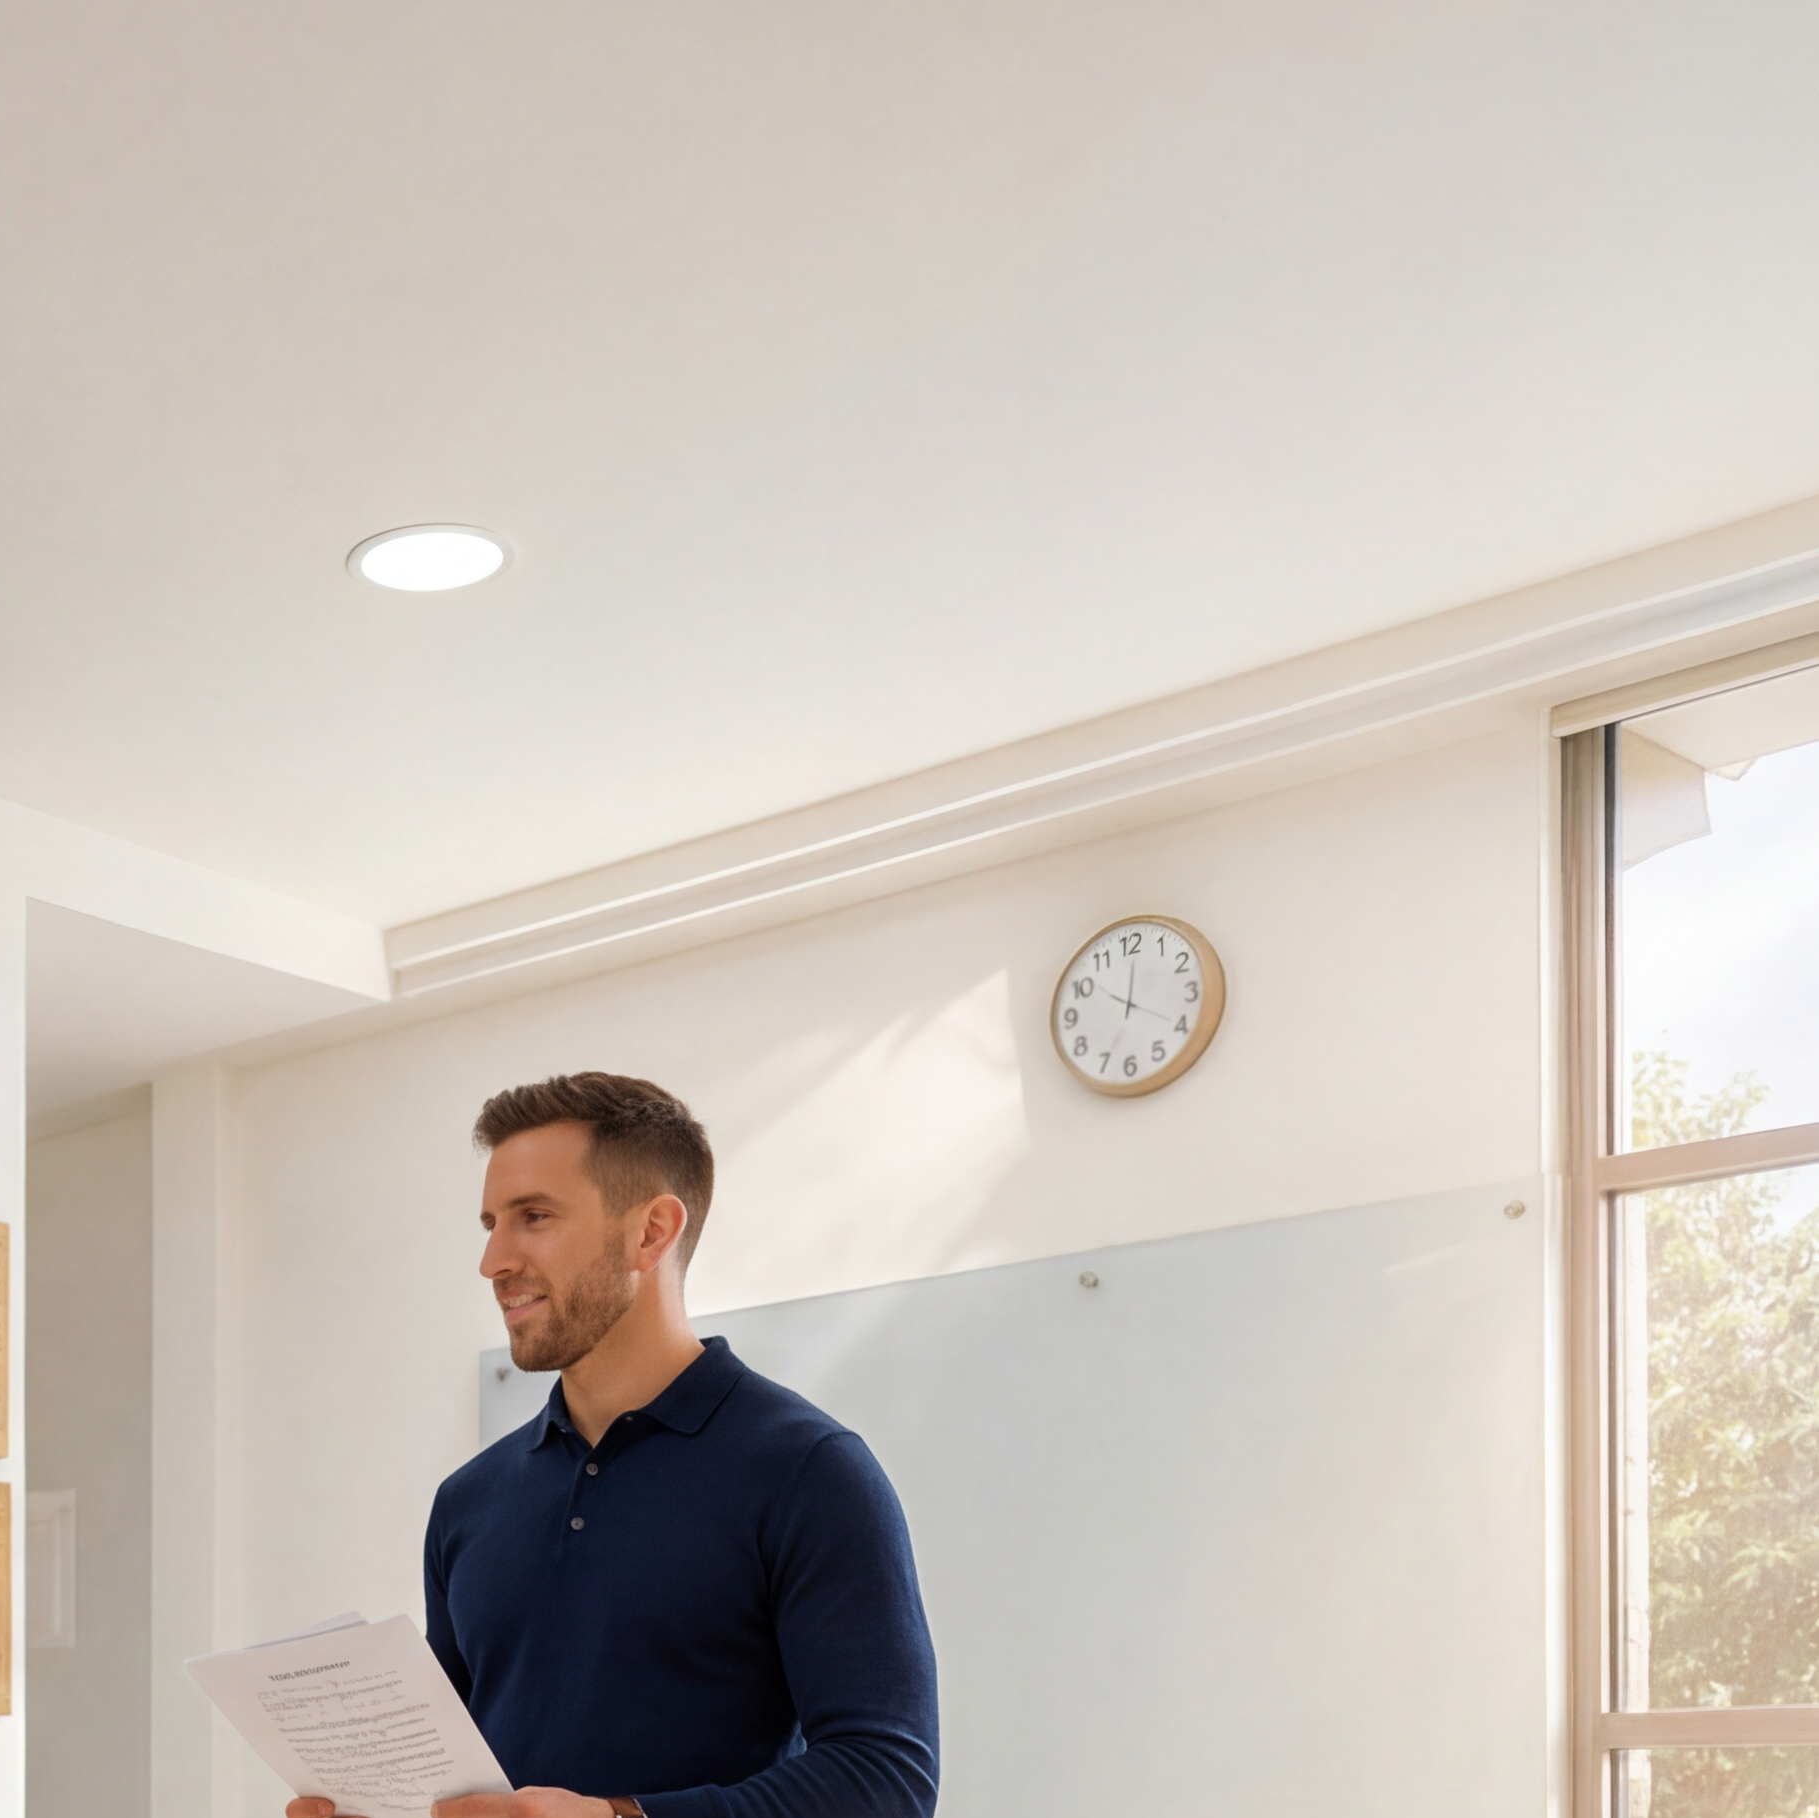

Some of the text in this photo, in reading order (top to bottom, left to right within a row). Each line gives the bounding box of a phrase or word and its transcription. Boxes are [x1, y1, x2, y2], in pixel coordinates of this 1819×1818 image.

[1119, 933, 1142, 957] 12
[1156, 936, 1165, 957] 1
[1093, 950, 1111, 972] 11
[1174, 952, 1190, 974] 2
[1072, 977, 1094, 1000] 10
[1184, 981, 1199, 1003] 3
[1064, 1008, 1079, 1029] 9
[1173, 1015, 1189, 1034] 4
[1073, 1036, 1088, 1057] 8
[1151, 1040, 1166, 1062] 5
[1099, 1053, 1111, 1074] 7
[1123, 1056, 1138, 1077] 6
